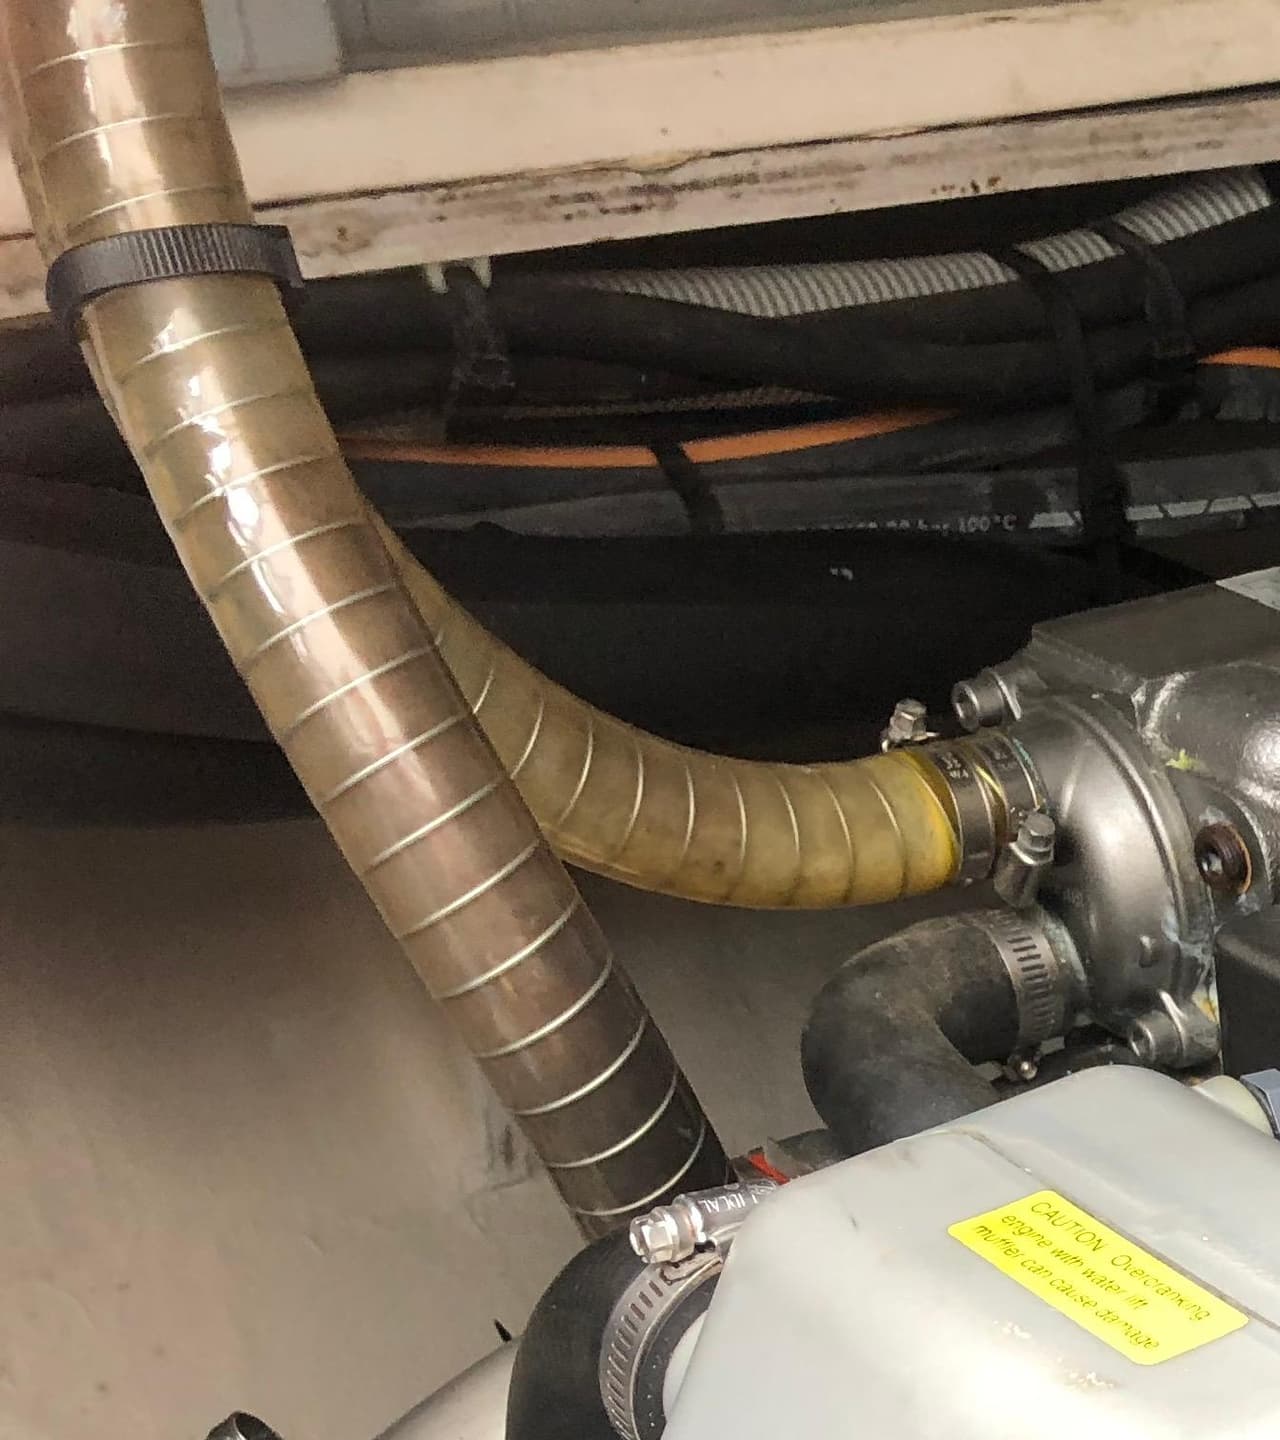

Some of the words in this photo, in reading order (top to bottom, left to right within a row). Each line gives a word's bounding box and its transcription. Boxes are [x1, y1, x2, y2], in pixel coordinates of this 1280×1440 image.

[974, 1223, 1025, 1260] muffler
[1020, 1258, 1053, 1280] can
[1049, 1277, 1098, 1309] cause
[1095, 1305, 1160, 1351] damage
[1001, 1214, 1053, 1248] engine
[1051, 1247, 1084, 1270] with
[1082, 1267, 1126, 1297] water
[1126, 1291, 1149, 1312] lift
[1030, 1201, 1106, 1253] CAUTION
[1110, 1254, 1211, 1322] Overcranking
